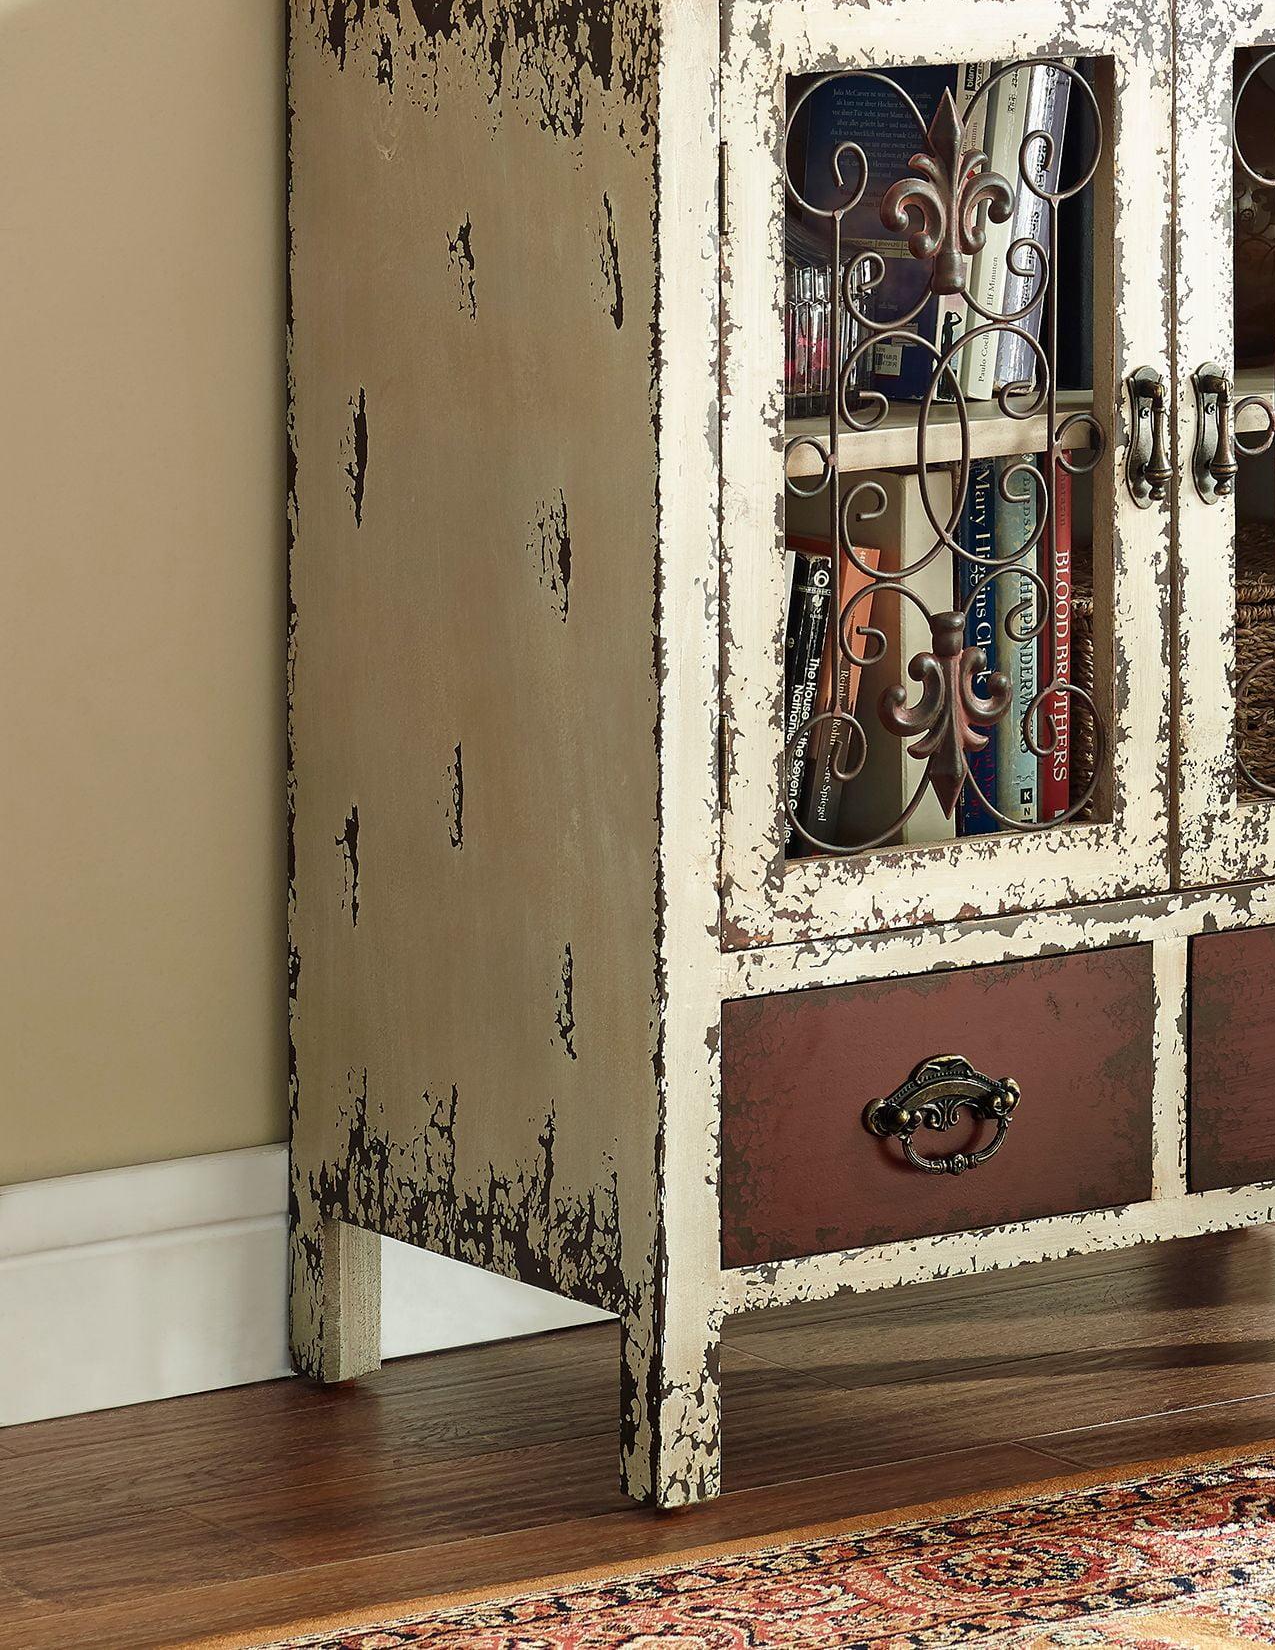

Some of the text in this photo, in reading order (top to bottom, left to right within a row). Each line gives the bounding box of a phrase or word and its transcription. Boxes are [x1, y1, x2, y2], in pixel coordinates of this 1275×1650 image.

[986, 256, 998, 306] Elf Minuten
[978, 355, 987, 382] Paulo
[969, 469, 990, 527] Mary
[807, 657, 820, 680] The
[1053, 550, 1070, 781] BLOOD BROTHERS
[786, 684, 804, 744] Nathanie
[801, 682, 817, 720] House
[795, 737, 808, 757] the
[789, 758, 804, 797] Seven
[817, 784, 832, 822] Spiegel
